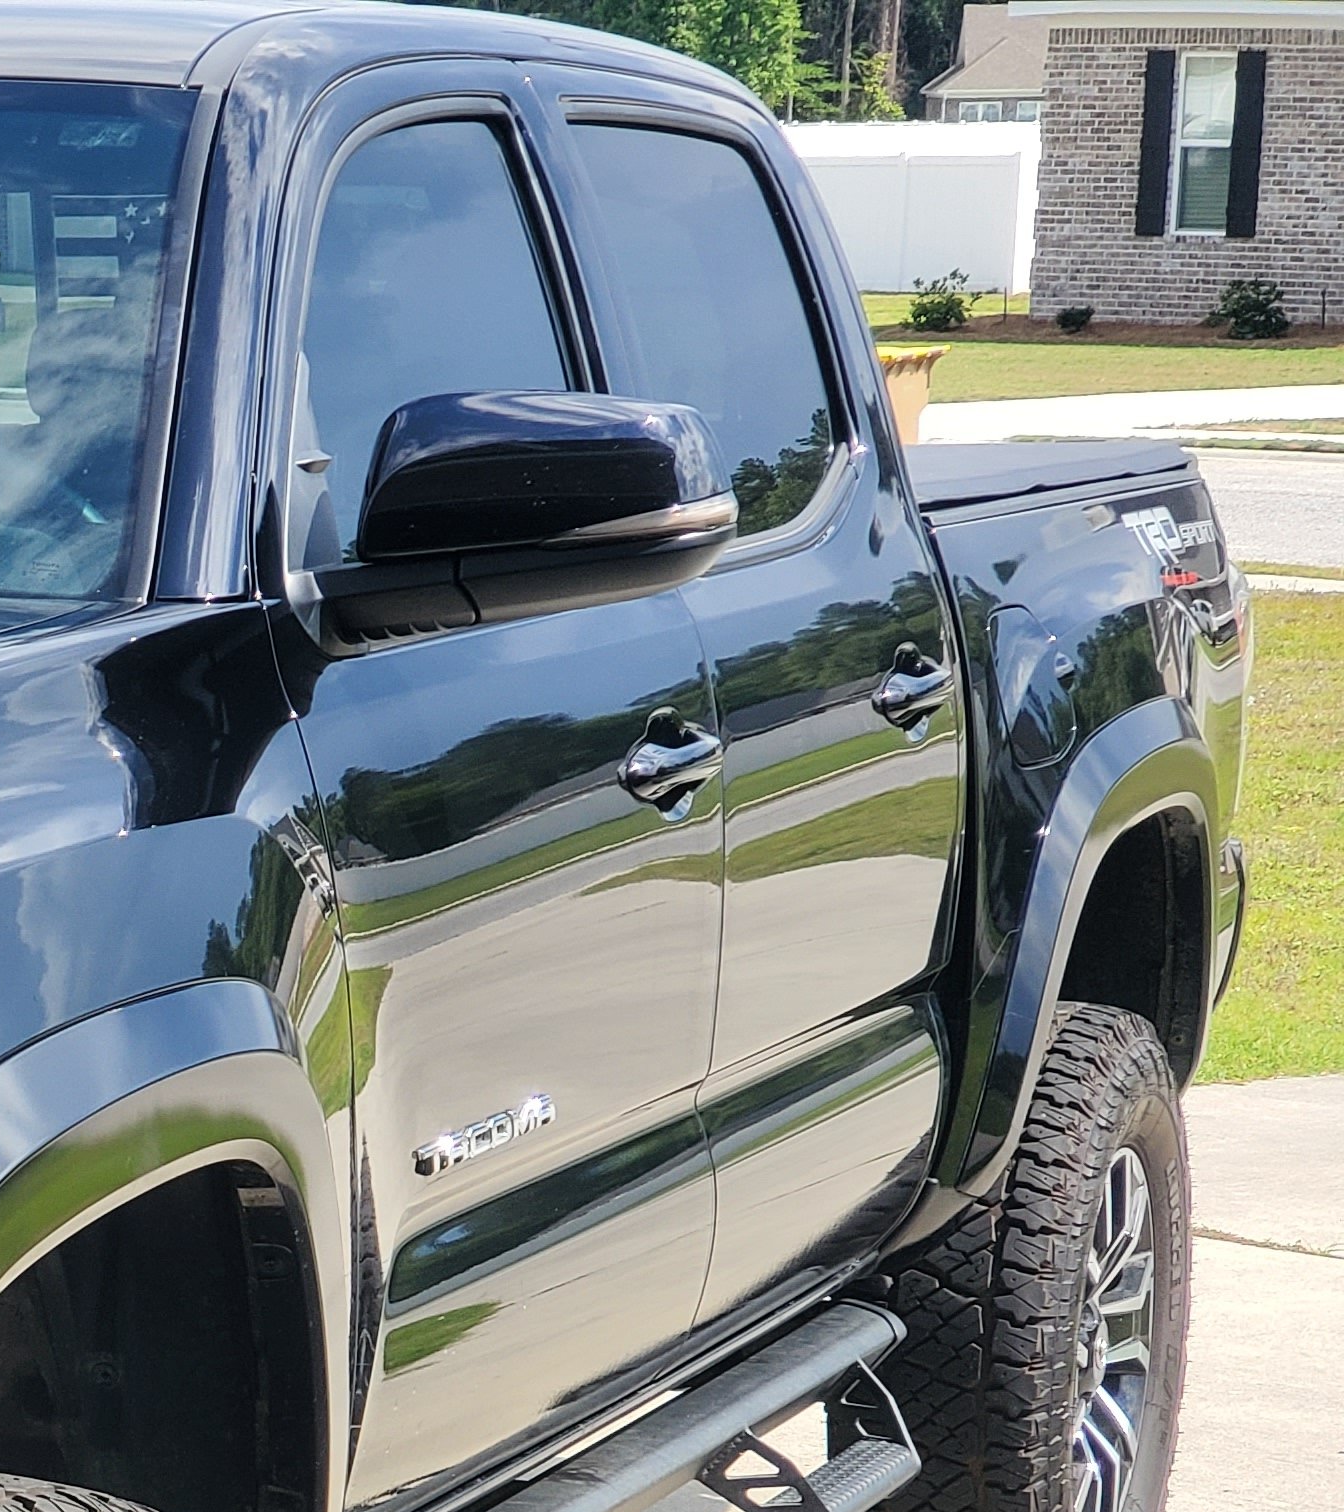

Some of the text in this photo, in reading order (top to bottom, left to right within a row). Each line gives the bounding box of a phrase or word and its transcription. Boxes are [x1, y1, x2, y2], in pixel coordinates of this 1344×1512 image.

[1121, 506, 1217, 567] TRD SPORT
[411, 1093, 557, 1176] TACOMA
